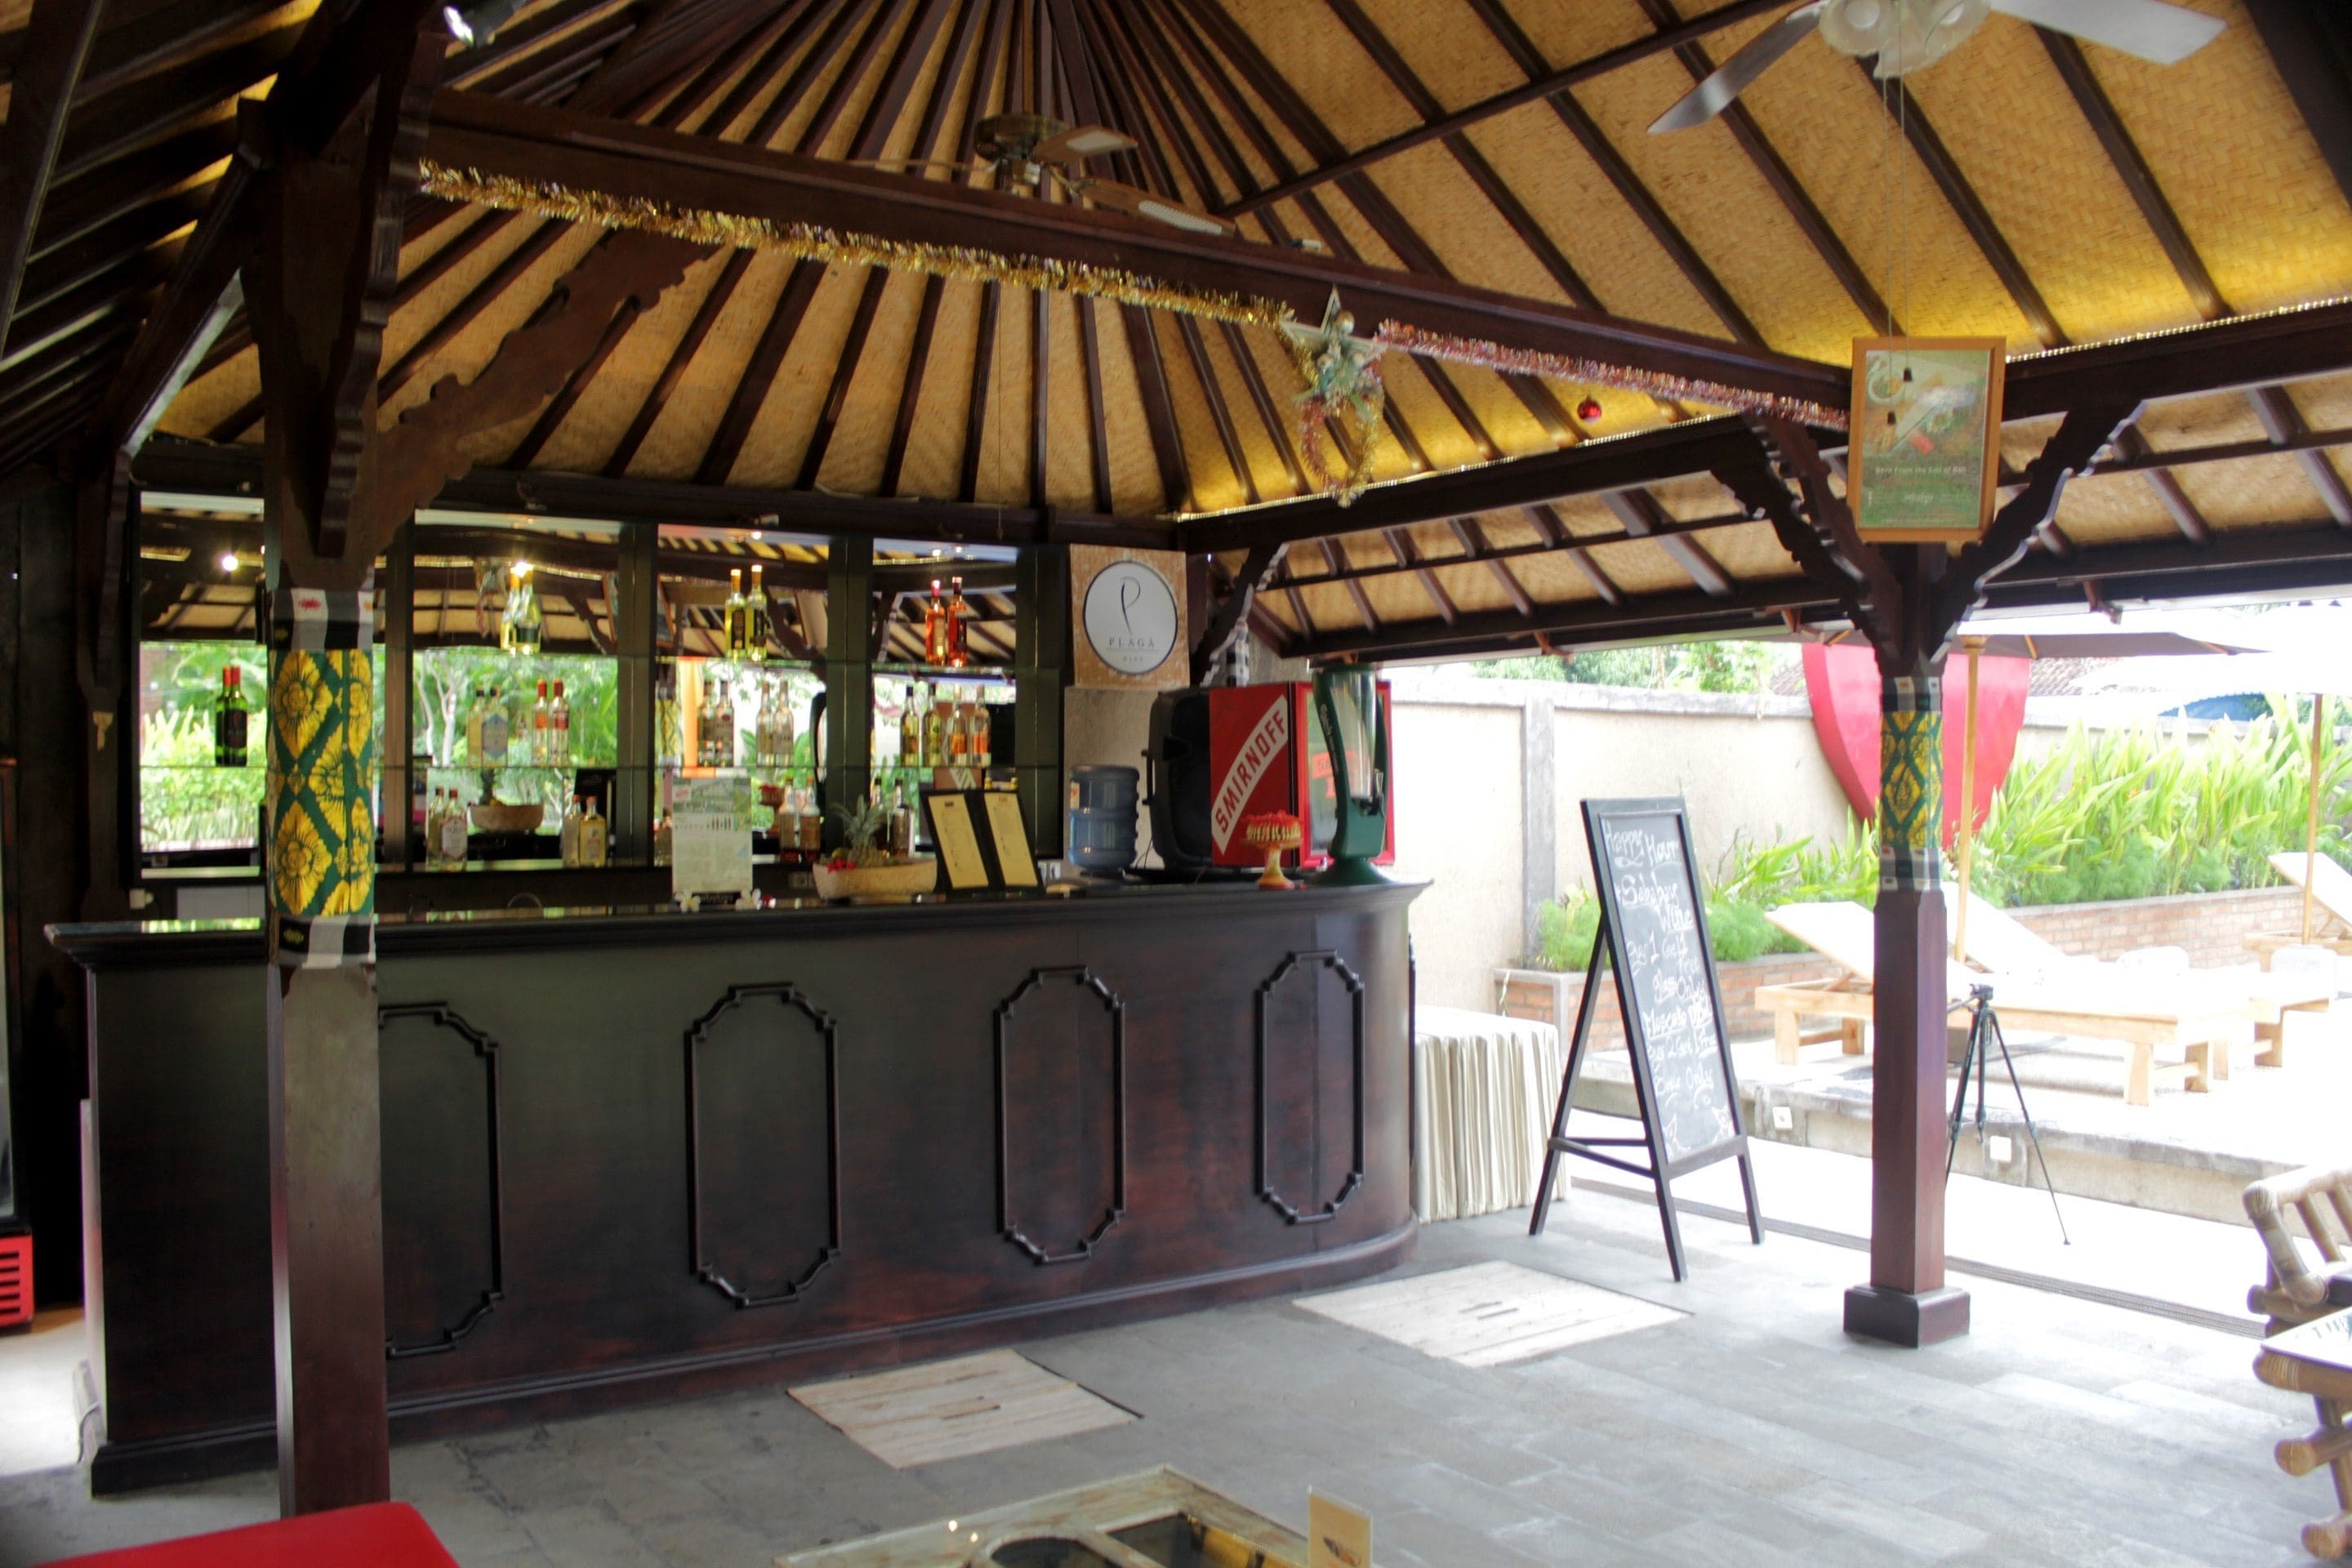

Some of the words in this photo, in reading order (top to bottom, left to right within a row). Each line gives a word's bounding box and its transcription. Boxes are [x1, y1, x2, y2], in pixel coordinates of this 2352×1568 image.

[1109, 637, 1156, 648] PLAGA
[1215, 710, 1285, 833] SMIRNOFF
[1605, 819, 1644, 862] Happy
[1644, 833, 1680, 868] Hour
[1654, 902, 1694, 933] Wine
[1650, 930, 1660, 964] 1
